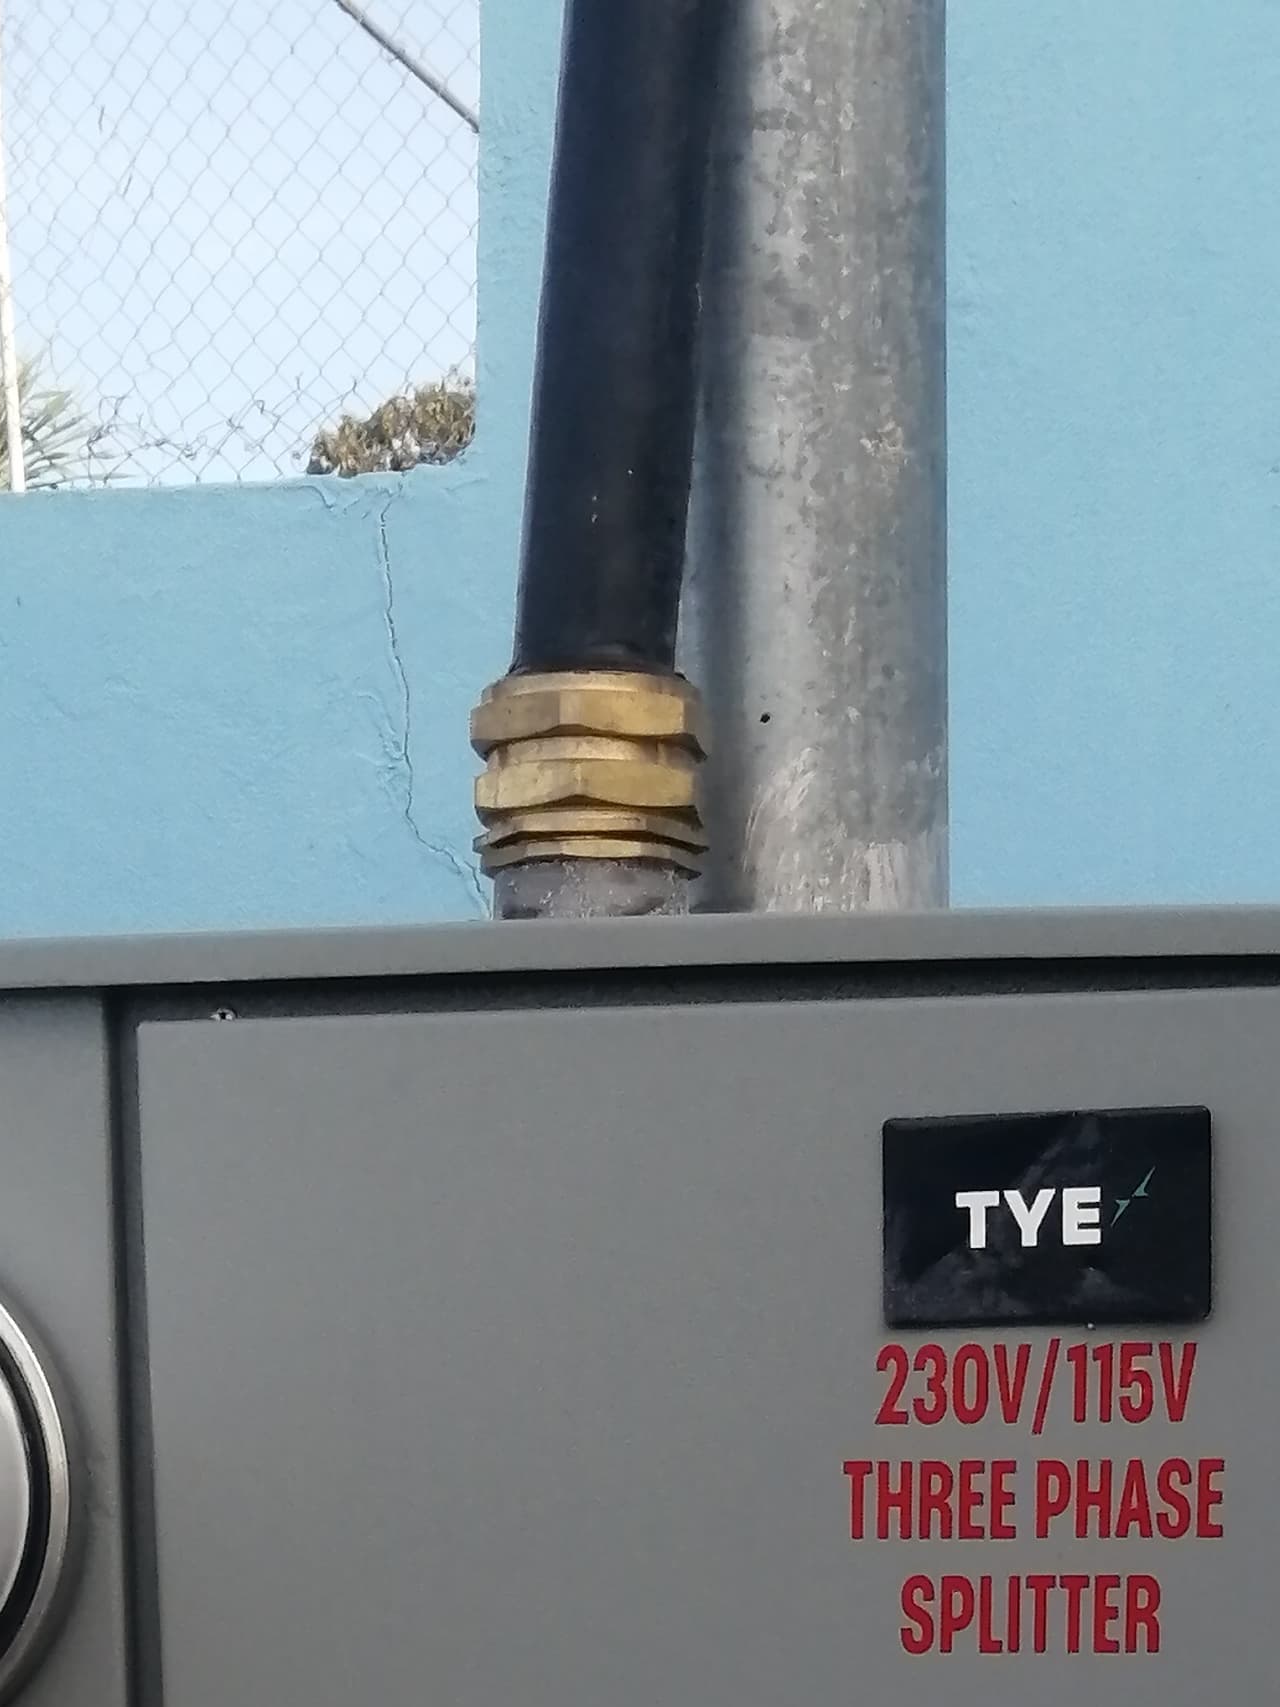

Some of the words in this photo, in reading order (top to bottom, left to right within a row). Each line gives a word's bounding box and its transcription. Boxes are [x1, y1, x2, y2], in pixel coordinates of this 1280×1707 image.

[955, 1186, 1102, 1249] TYE
[874, 1338, 1198, 1435] 230V/115V
[842, 1459, 1018, 1540] THREE
[1034, 1458, 1226, 1539] PHASE
[899, 1573, 1161, 1655] SPLITTER
